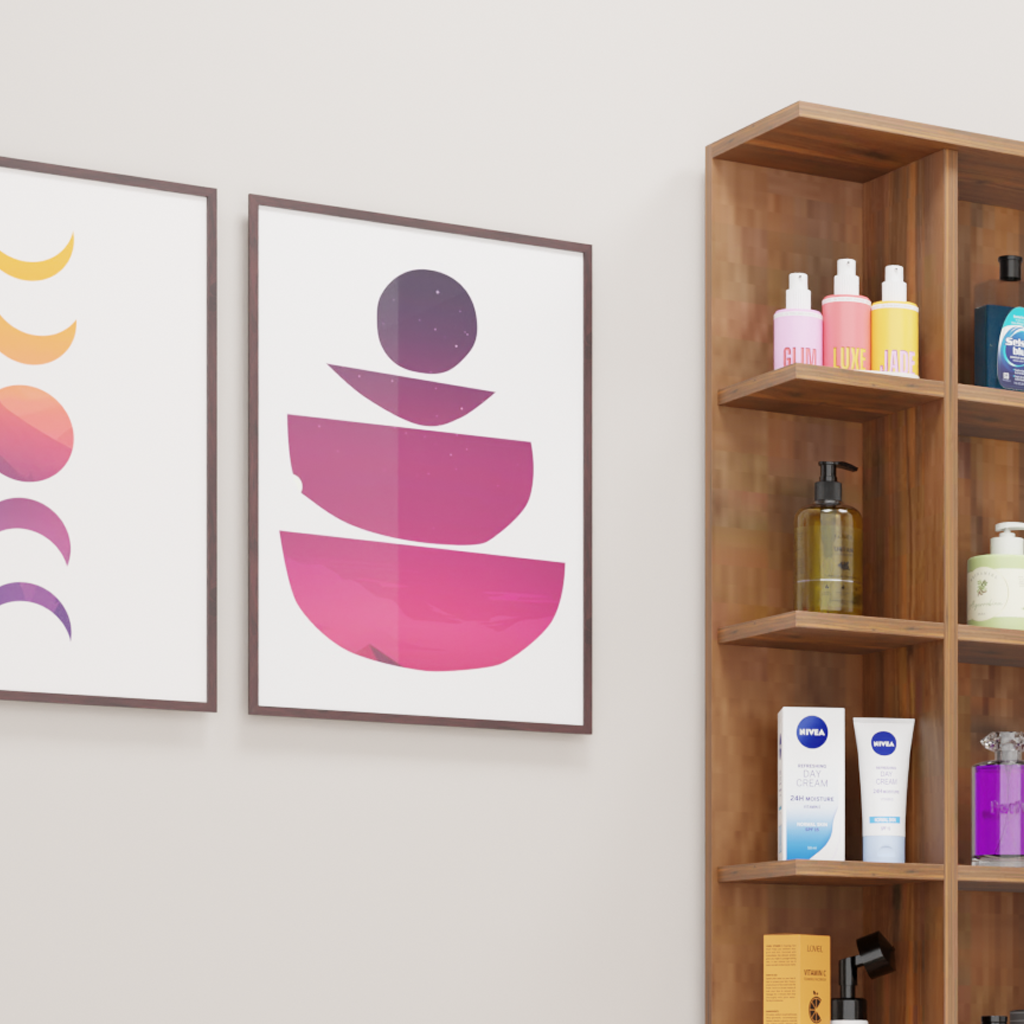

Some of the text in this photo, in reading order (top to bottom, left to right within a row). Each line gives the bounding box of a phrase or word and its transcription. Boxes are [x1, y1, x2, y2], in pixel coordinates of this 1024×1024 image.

[833, 346, 866, 370] LUXE
[879, 349, 916, 374] JADE
[799, 728, 826, 736] NIVEA
[803, 769, 822, 778] DAY
[797, 779, 829, 787] CREAM
